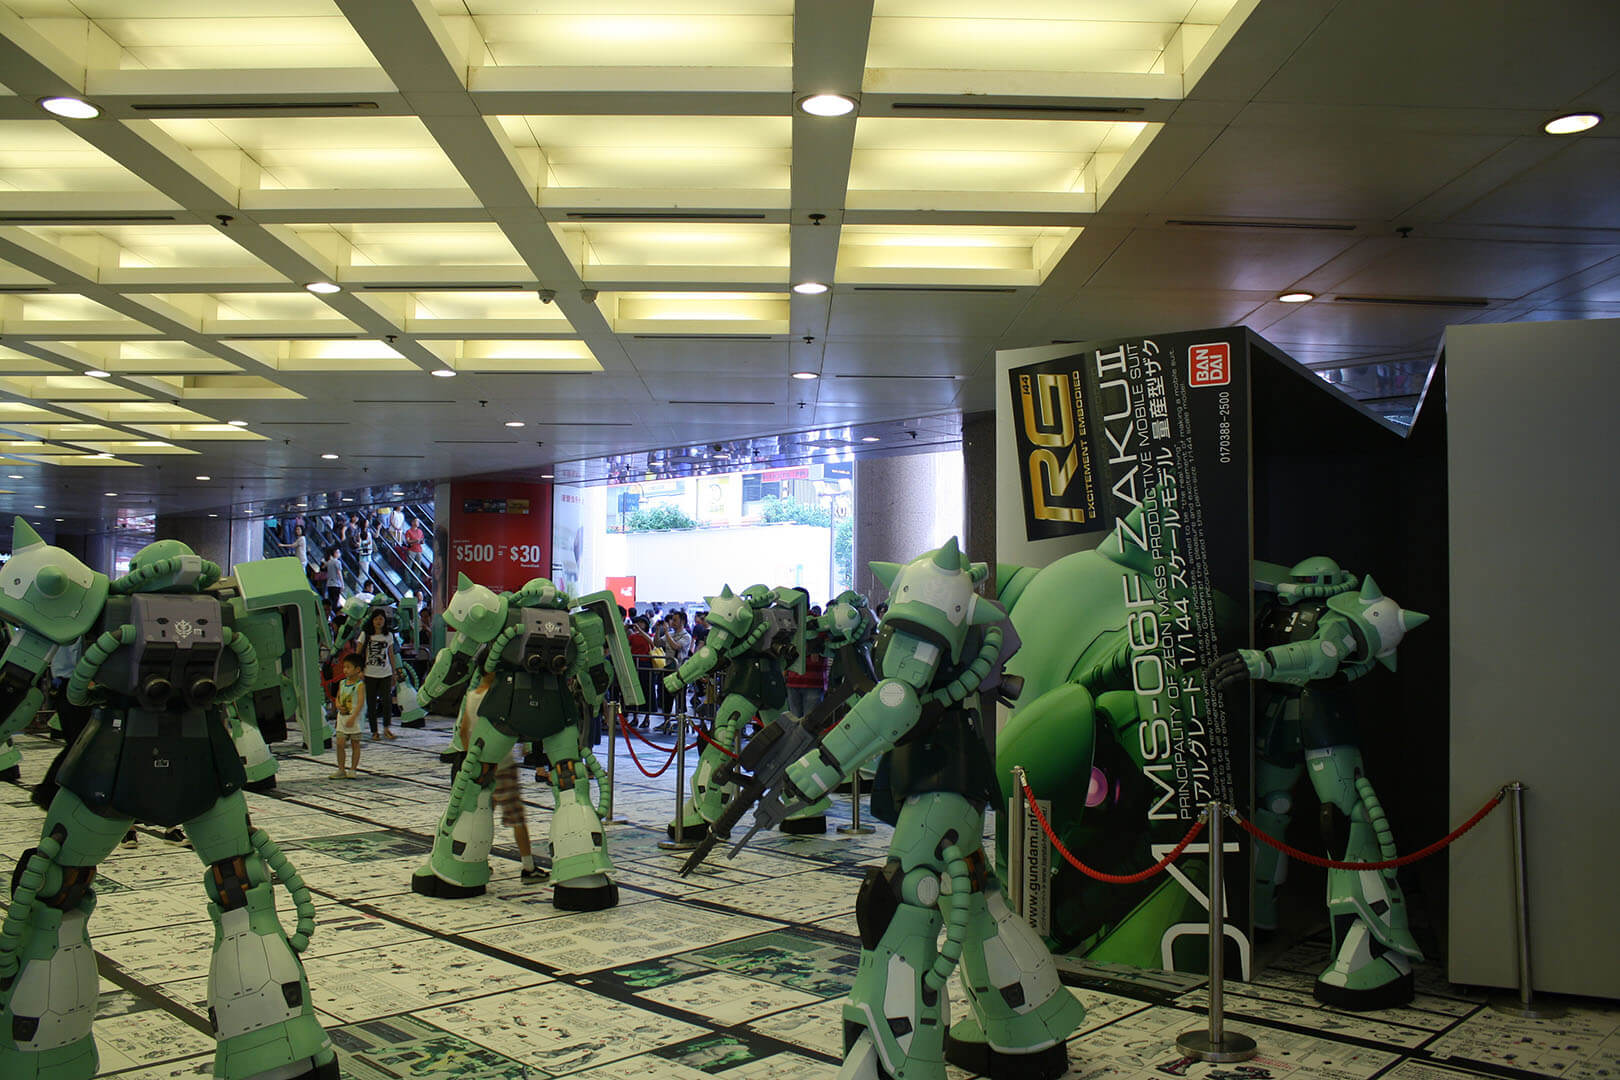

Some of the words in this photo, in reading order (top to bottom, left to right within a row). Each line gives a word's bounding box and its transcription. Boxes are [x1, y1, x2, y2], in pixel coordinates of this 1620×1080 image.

[1126, 342, 1141, 379] SUIT
[1196, 348, 1209, 382] BAN
[1210, 354, 1223, 380] DAI
[1141, 337, 1170, 440] 量産型ザク
[1170, 368, 1180, 396] mobile
[1072, 370, 1087, 436] EMBODIED
[1131, 383, 1150, 446] MOBILE
[1175, 406, 1186, 437] making
[1182, 411, 1191, 434] scale
[1218, 392, 1231, 463] 0170388-2500
[1019, 374, 1086, 523] RG
[1080, 440, 1096, 520] EXCITEMENT
[1177, 470, 1185, 488] real
[1182, 450, 1194, 500] excitement
[1140, 450, 1164, 559] PRODUCTIVE
[1154, 445, 1188, 588] スケールモデル
[456, 544, 494, 562] $500
[510, 545, 540, 563] $30
[1185, 537, 1194, 564] aimed
[1190, 521, 1201, 560] pleasure
[1195, 562, 1203, 577] the
[1199, 538, 1211, 597] incorporated
[1153, 564, 1170, 616] MASS
[1198, 591, 1209, 629] Gundam
[1172, 596, 1197, 665] 1/144
[1194, 611, 1202, 636] name
[1206, 599, 1216, 642] gimmicks
[1160, 622, 1176, 670] ZEON
[1121, 571, 1178, 821] MS-06F
[1165, 675, 1179, 698] OF
[1204, 698, 1213, 725] brand
[1207, 727, 1215, 746] new
[1168, 703, 1192, 819] PRINCIPALITY
